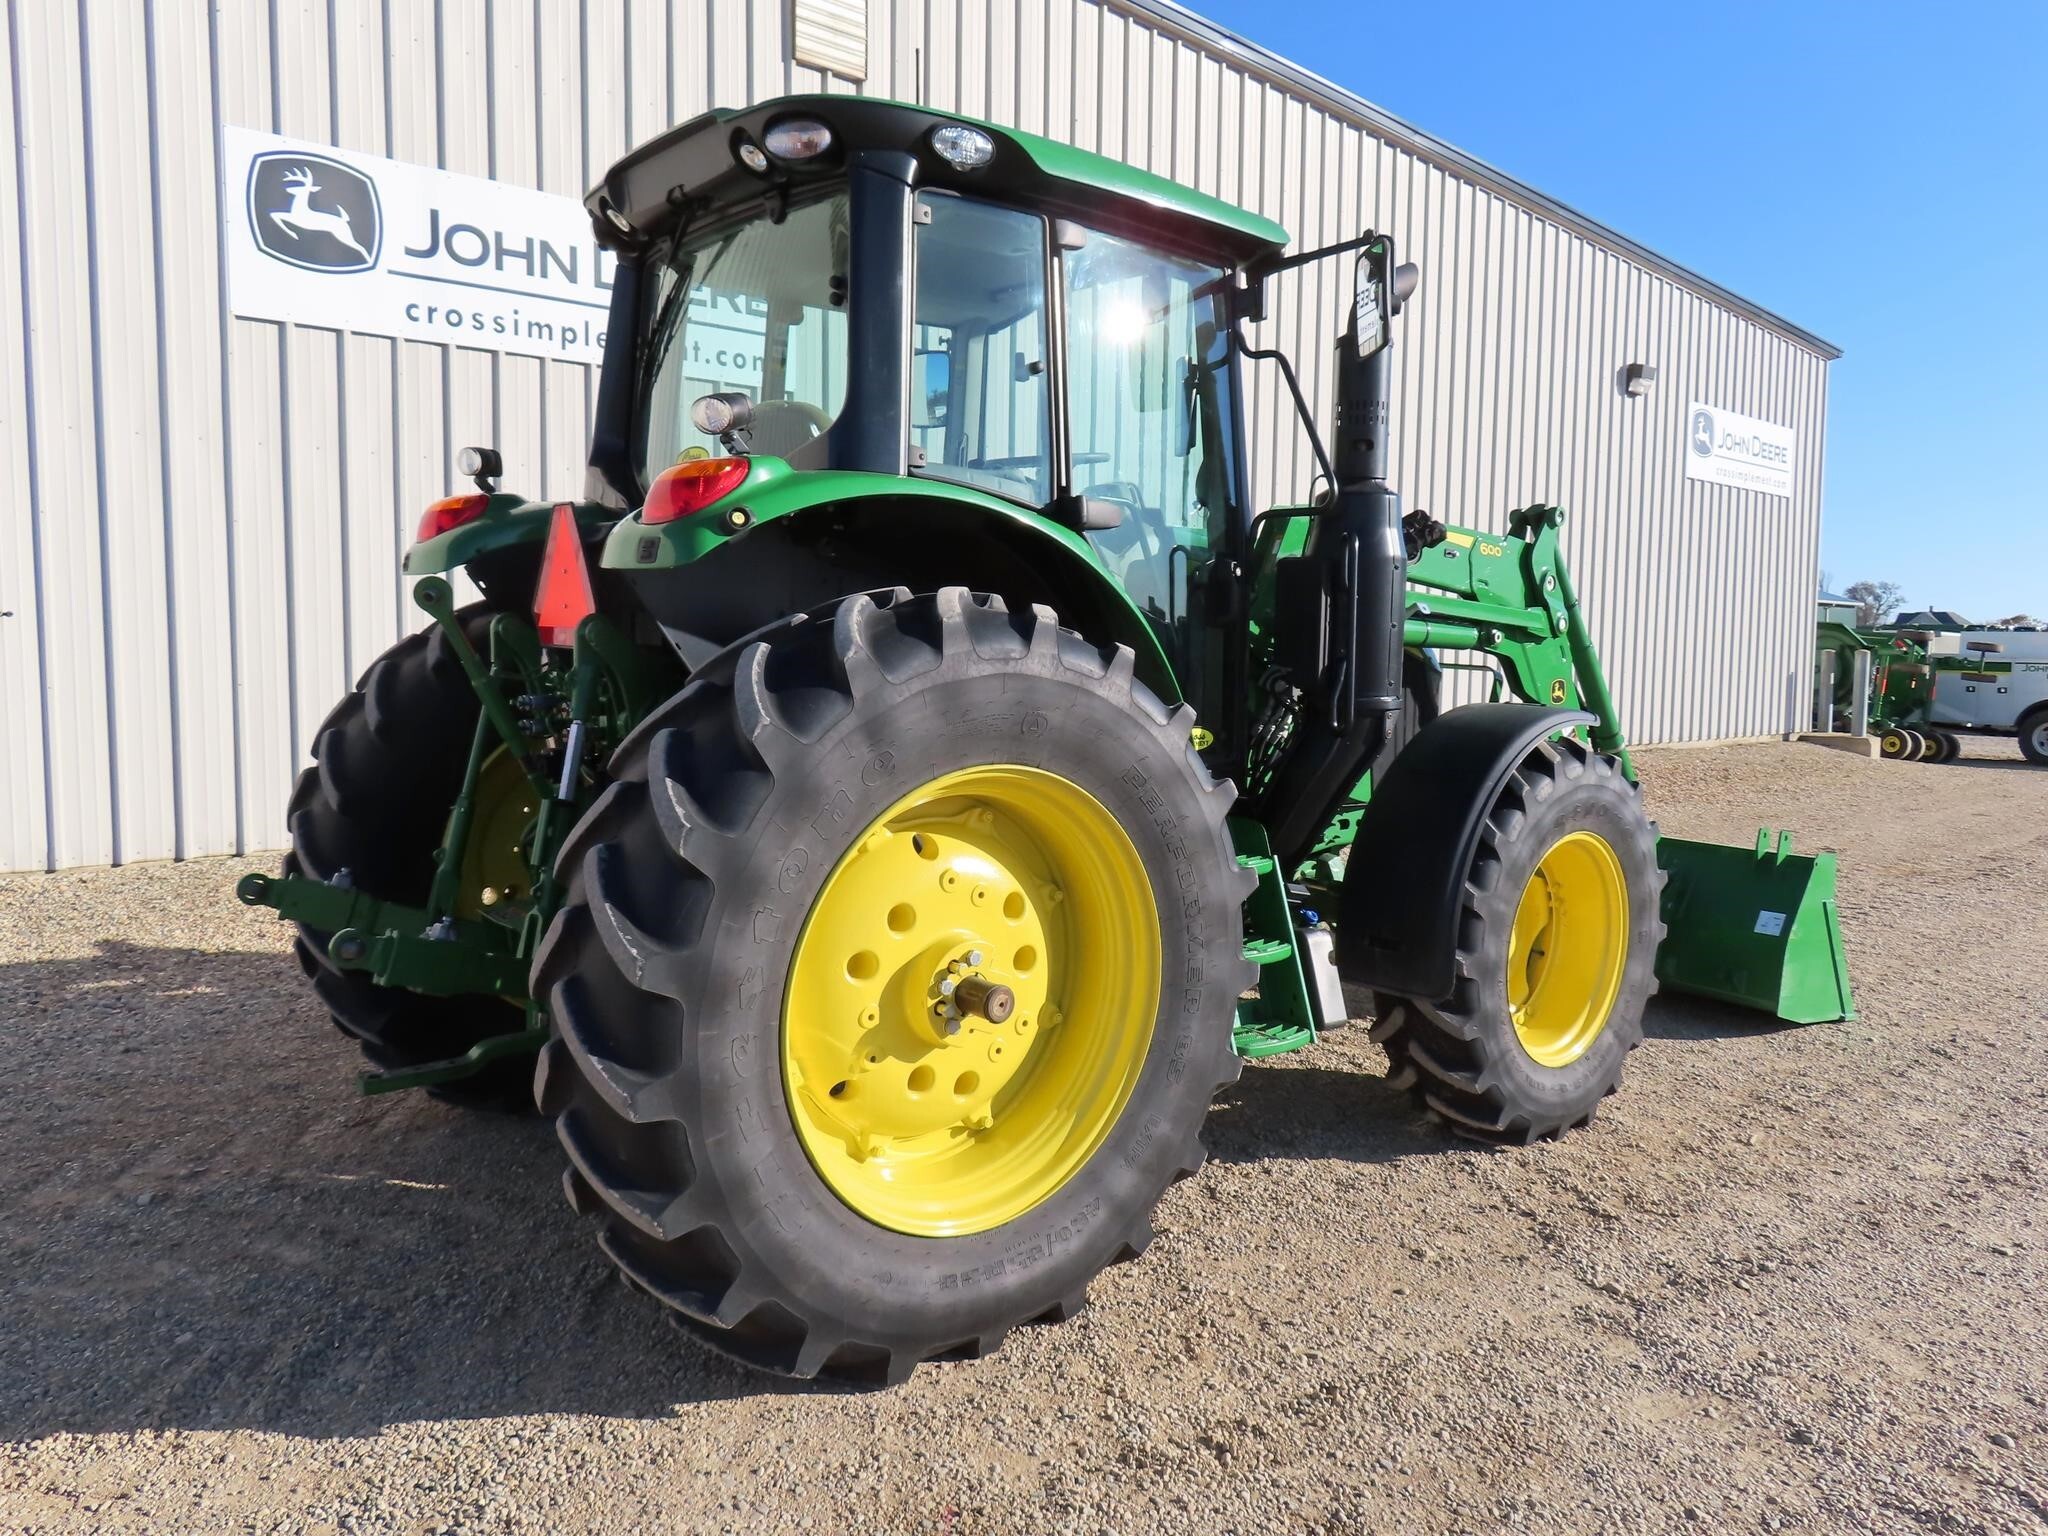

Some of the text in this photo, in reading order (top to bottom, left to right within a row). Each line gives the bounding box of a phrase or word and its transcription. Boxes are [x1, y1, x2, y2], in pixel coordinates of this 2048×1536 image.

[404, 208, 578, 285] JOHN
[1718, 428, 1788, 464] JOHN DEERE
[1480, 542, 1502, 557] 600
